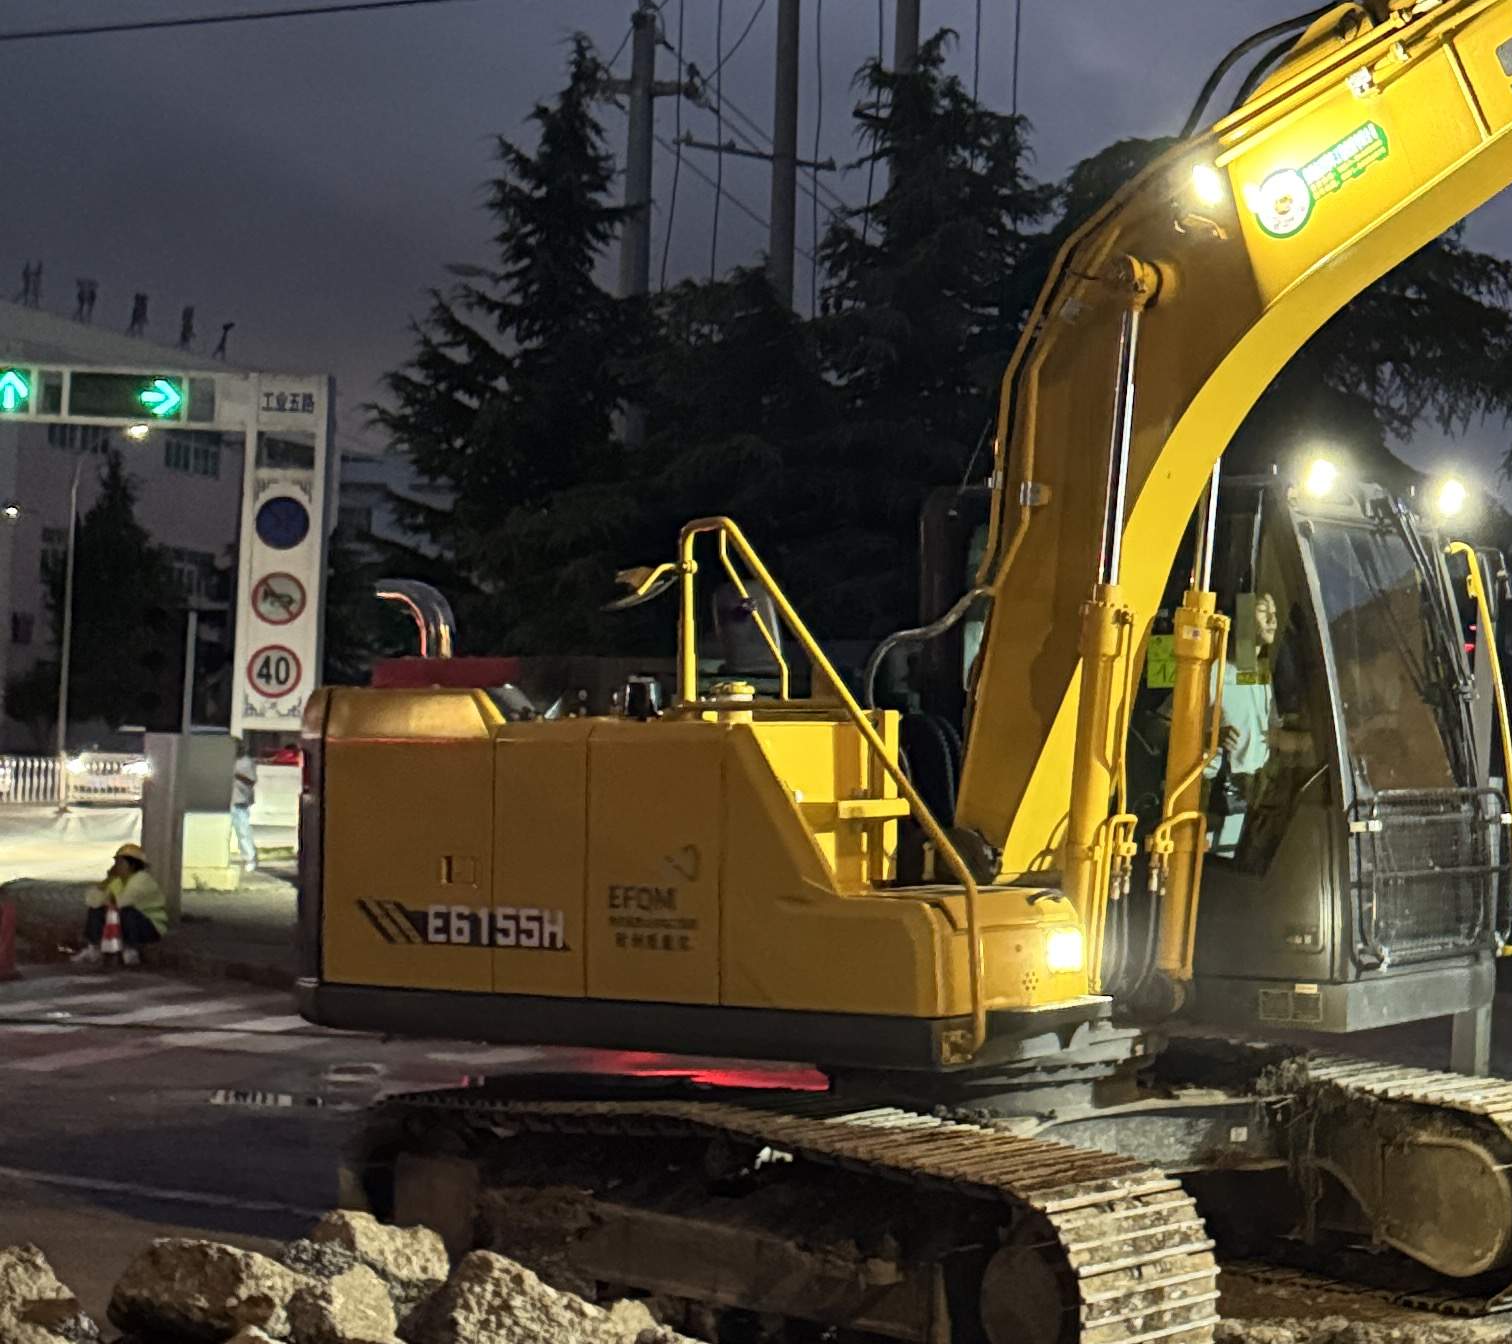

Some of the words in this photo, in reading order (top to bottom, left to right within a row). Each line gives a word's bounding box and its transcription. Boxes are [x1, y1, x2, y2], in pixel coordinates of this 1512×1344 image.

[262, 391, 314, 414] 工业五路
[256, 655, 290, 685] 40
[427, 905, 564, 949] E6155H
